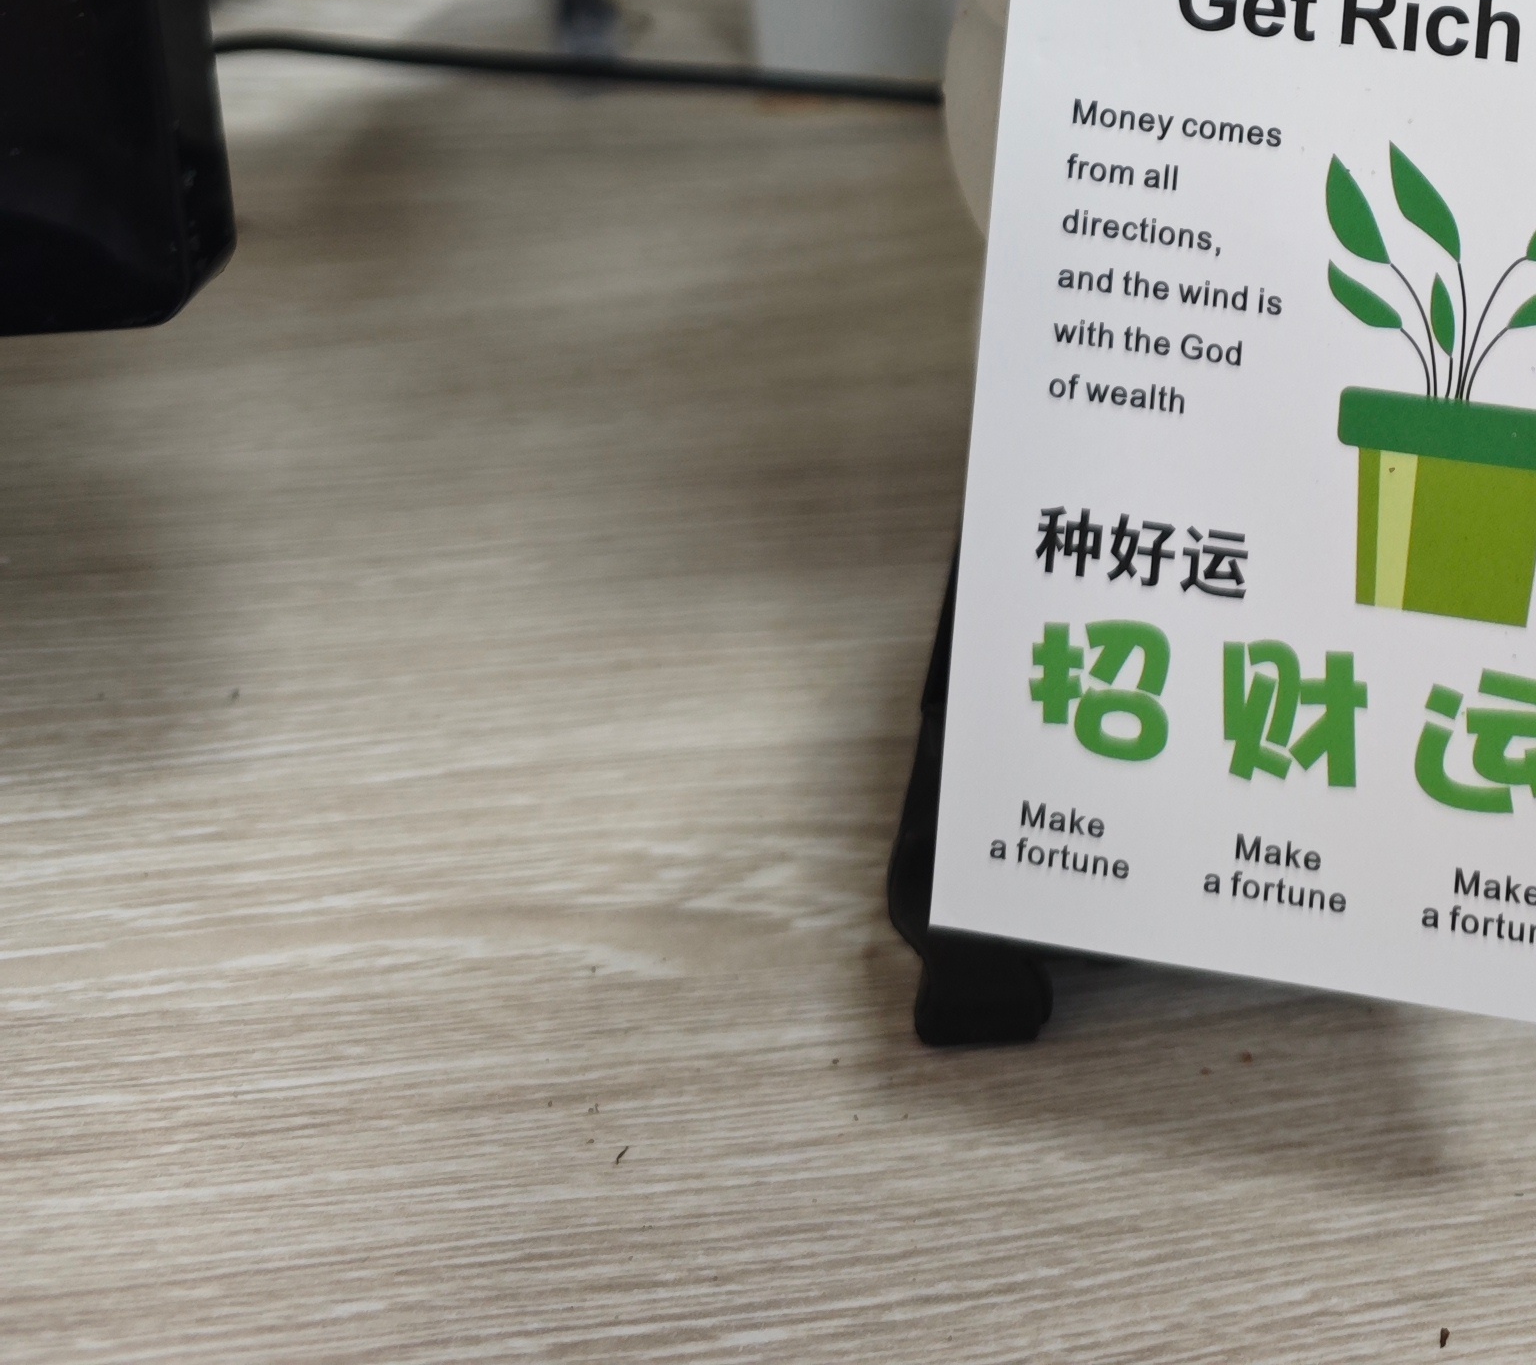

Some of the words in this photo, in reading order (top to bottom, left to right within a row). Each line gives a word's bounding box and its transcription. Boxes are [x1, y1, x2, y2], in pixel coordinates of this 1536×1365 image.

[1072, 98, 1174, 141] Money
[1181, 117, 1282, 148] comes
[1066, 153, 1135, 186] from
[1143, 164, 1179, 191] all
[1062, 208, 1221, 257] directions,
[1057, 267, 1114, 294] and
[1122, 271, 1170, 301] the
[1178, 283, 1249, 312] wind
[1258, 287, 1282, 316] is
[1053, 321, 1114, 349] with
[1123, 326, 1171, 356] the
[1180, 333, 1243, 367] God
[1048, 373, 1081, 400] of
[1086, 382, 1185, 415] wealth
[1035, 506, 1249, 600] 种好运
[1020, 800, 1105, 839] Make
[989, 839, 1007, 861] a
[1016, 833, 1130, 880] fortune
[1234, 833, 1322, 875] Make
[1203, 873, 1221, 895] a
[1230, 866, 1347, 913] fortune
[1421, 907, 1439, 930] a
